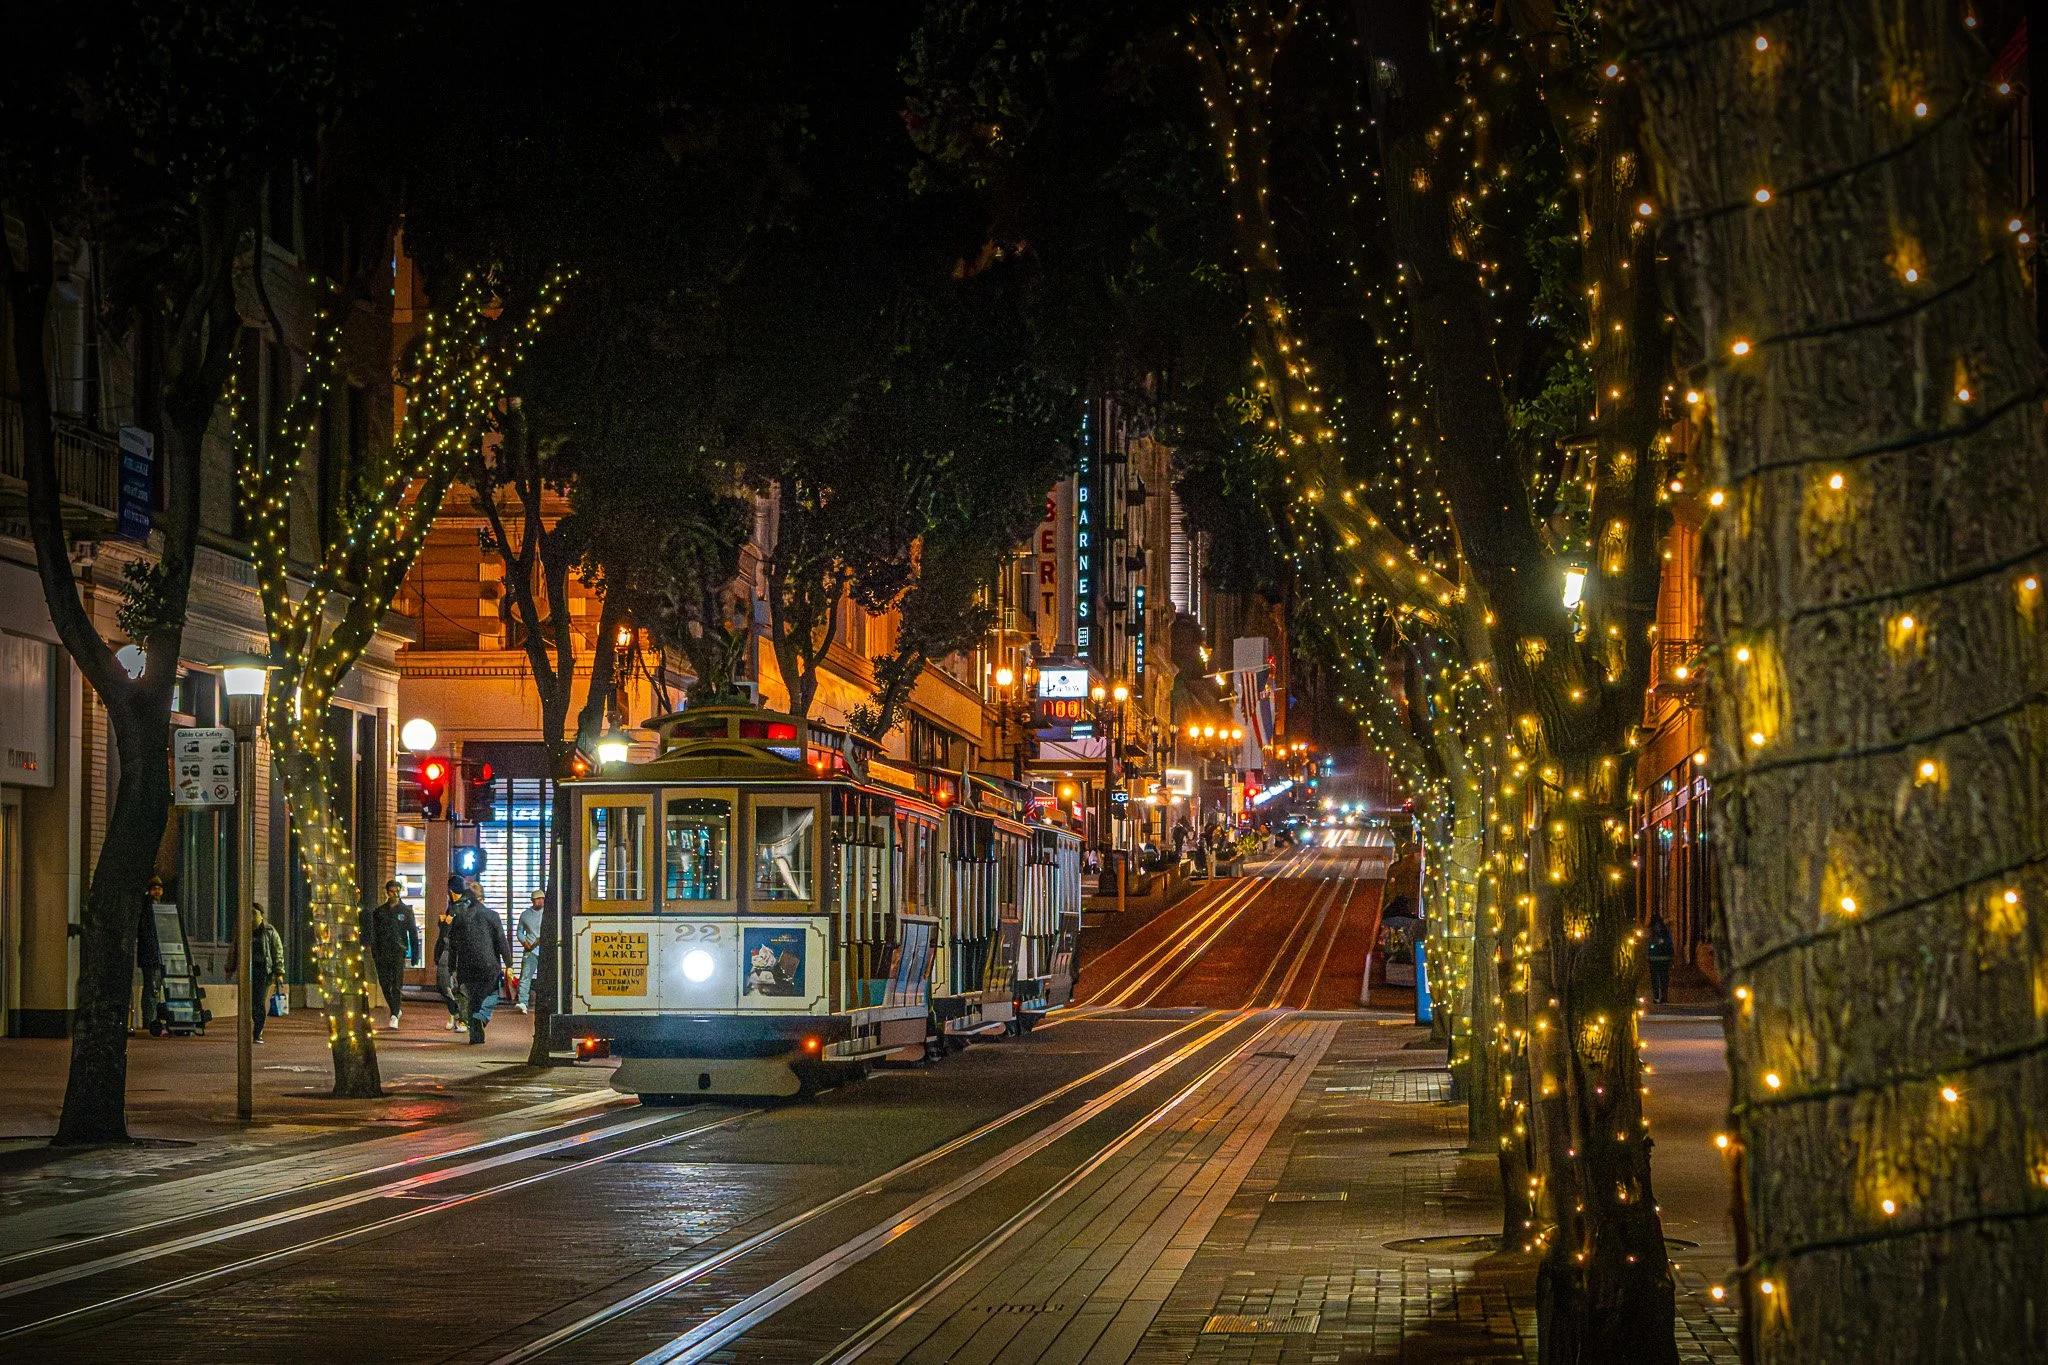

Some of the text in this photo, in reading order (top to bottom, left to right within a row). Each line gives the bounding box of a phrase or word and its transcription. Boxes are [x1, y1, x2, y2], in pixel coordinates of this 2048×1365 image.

[1040, 484, 1056, 616] BERT
[1078, 487, 1089, 617] BARNES
[1111, 793, 1128, 802] UGG
[594, 935, 646, 944] POWELL
[675, 924, 721, 943] 22
[592, 968, 645, 977] BAY TAYLOR
